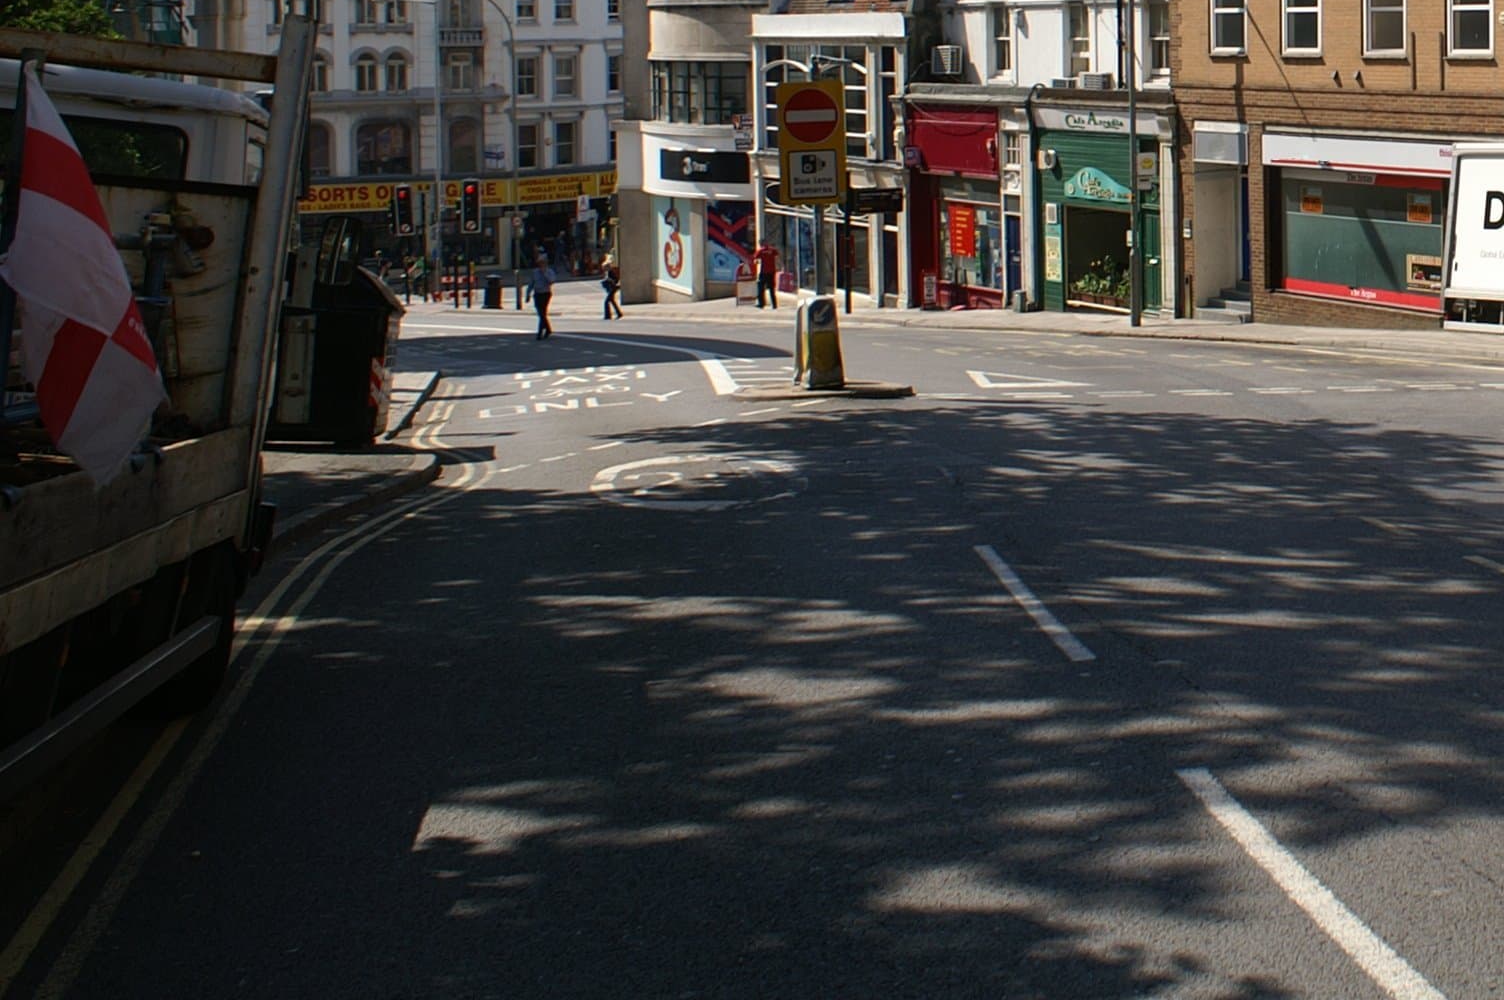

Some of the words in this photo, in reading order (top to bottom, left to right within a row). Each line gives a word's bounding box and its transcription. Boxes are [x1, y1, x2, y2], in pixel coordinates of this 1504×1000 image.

[307, 185, 369, 202] SORTS
[508, 370, 647, 389] TAXI
[478, 390, 683, 420] ONLY
